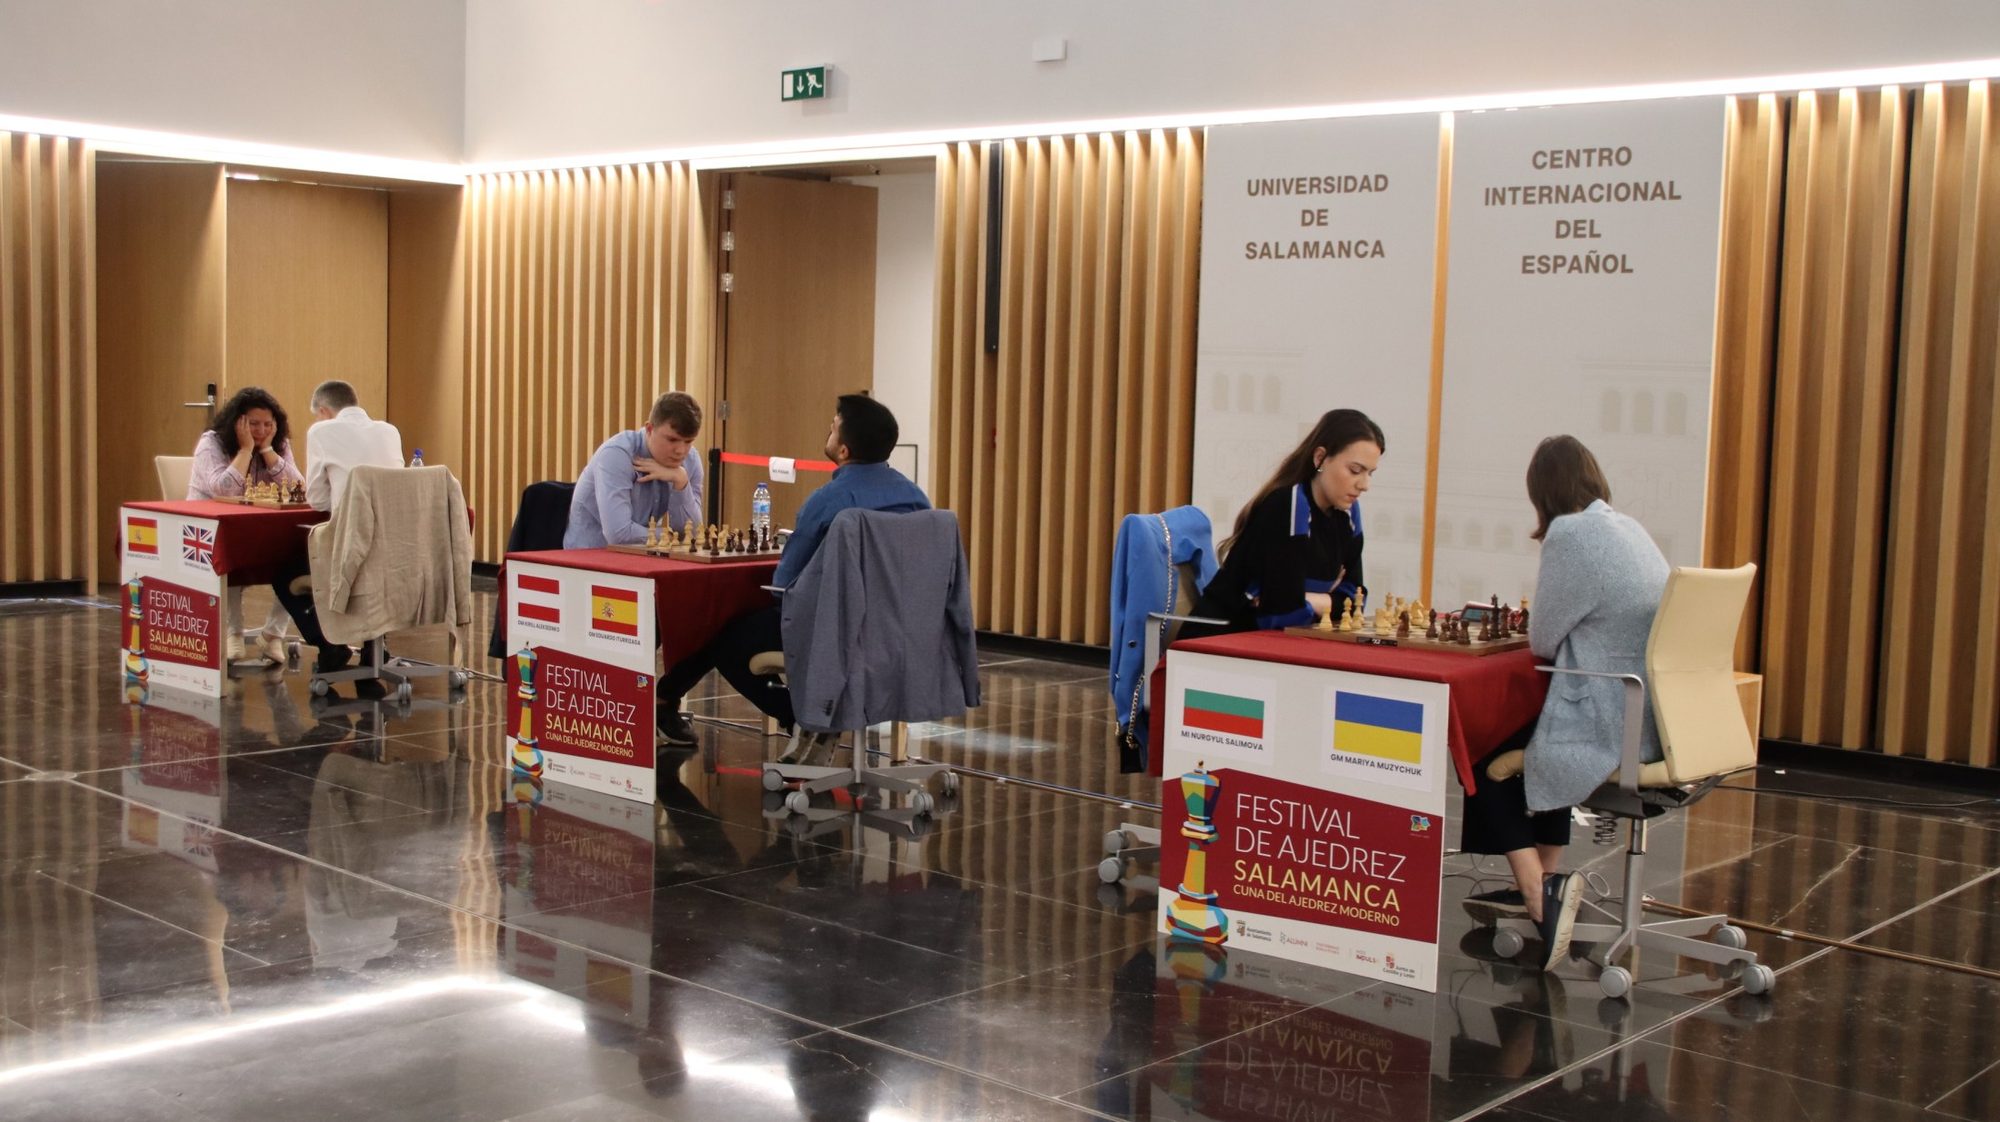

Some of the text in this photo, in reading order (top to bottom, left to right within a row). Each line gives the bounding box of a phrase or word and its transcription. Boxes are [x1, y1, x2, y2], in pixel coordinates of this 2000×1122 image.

[1531, 146, 1633, 170] CENTRO
[1246, 174, 1389, 197] UNIVERSIDAD
[1483, 181, 1682, 207] INTERNACIONAL
[1300, 209, 1329, 228] DE
[1554, 219, 1602, 240] DEL
[1244, 239, 1386, 260] SALAMANCA
[1521, 249, 1634, 275] ESPAÑOL
[150, 590, 194, 613] FESTIVAL
[150, 609, 208, 636] DE AJEDREZ
[150, 629, 208, 654] SALAMANCA
[546, 664, 612, 695] FESTIVAL
[546, 688, 636, 726] DE AJEDREZ
[546, 713, 634, 747] SALAMANCA
[1181, 730, 1264, 751] MI NURGYUL SALIMOVA
[546, 731, 634, 758] CUNA DEL AJEDREZ MODERNO
[1330, 754, 1422, 776] GM MARIYA MUZYCHUK
[1236, 793, 1360, 840] FESTIVAL
[1234, 826, 1407, 882] DE AJEDREZ
[1234, 859, 1400, 912] SALAMANCA
[1233, 884, 1400, 927] CUNA DEL AJEDREZ MODERNO
